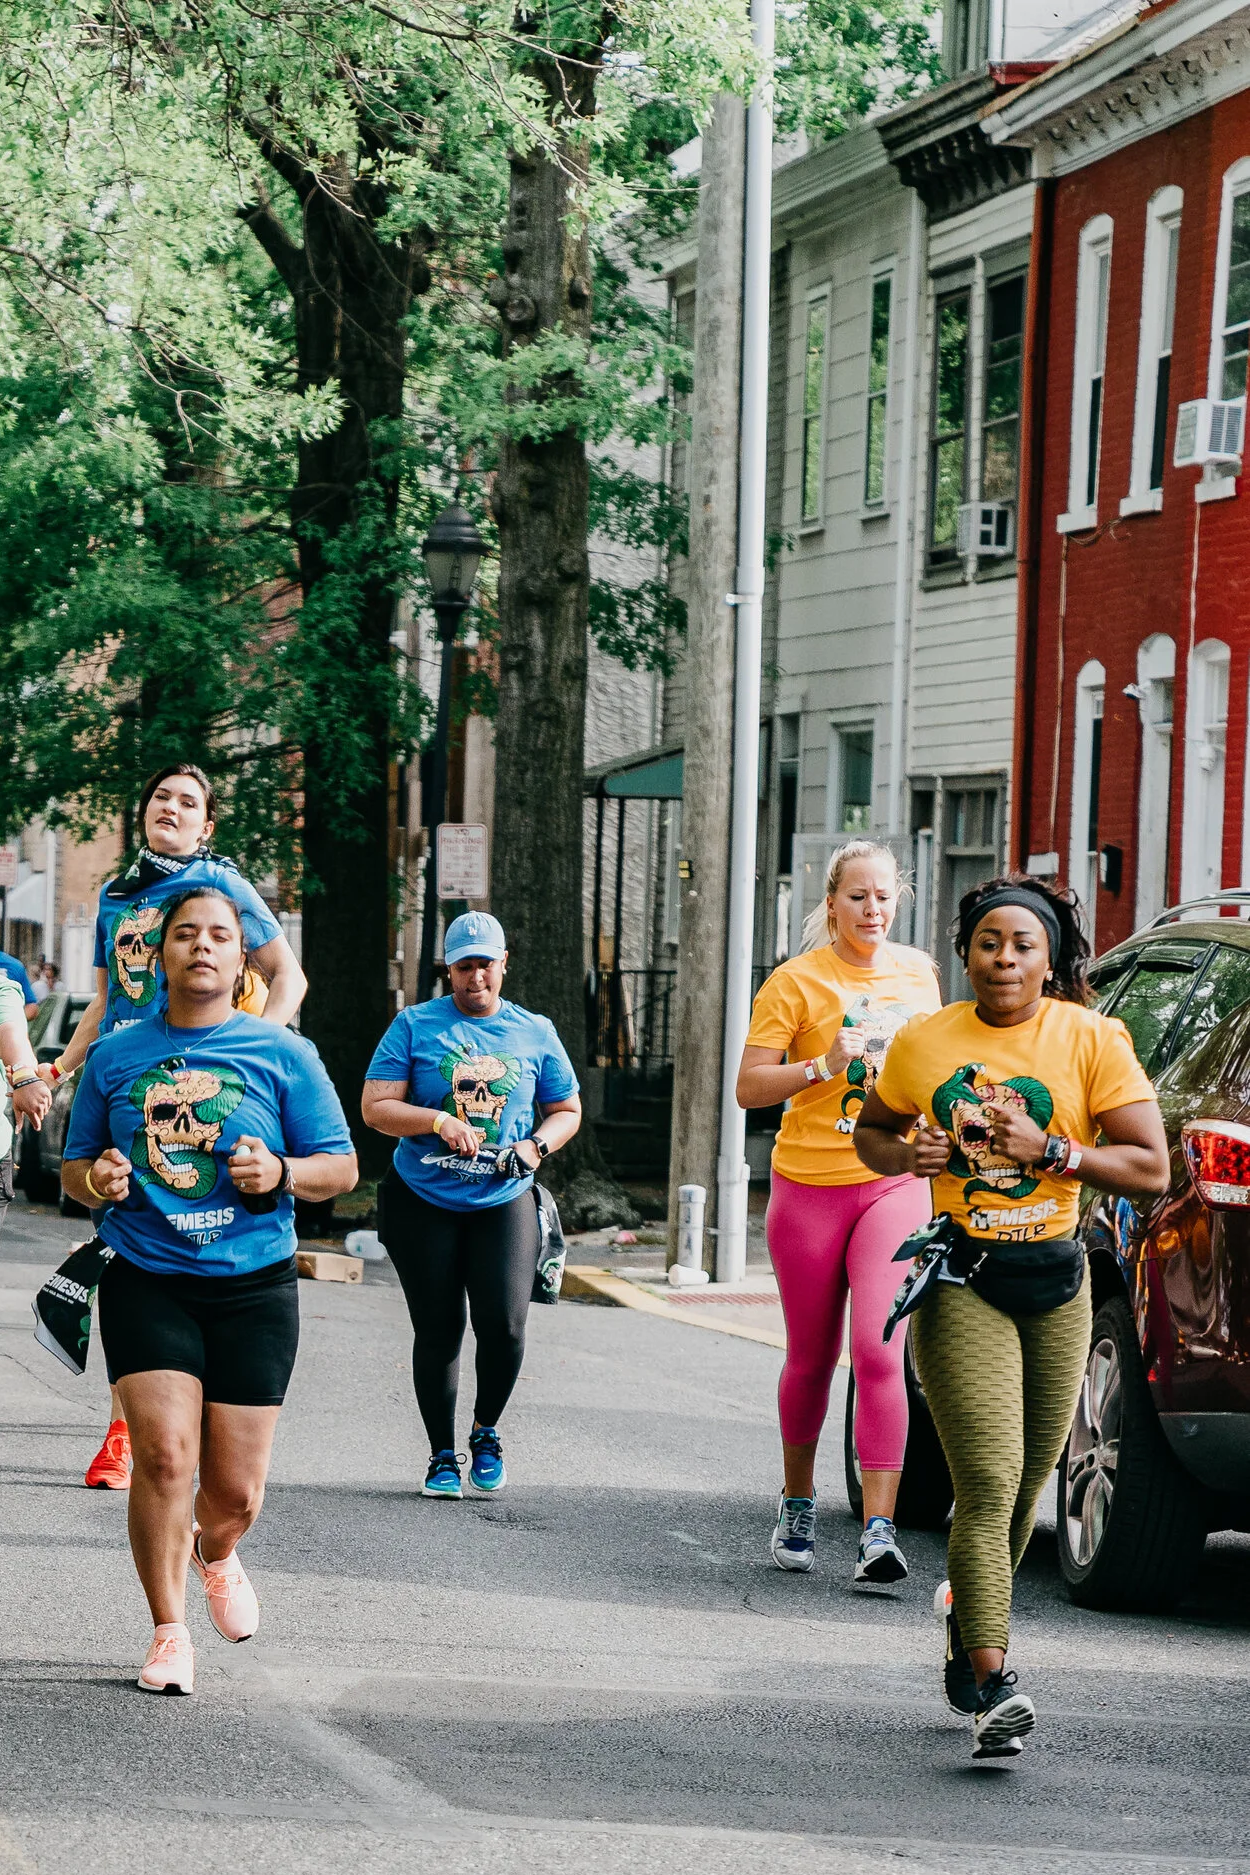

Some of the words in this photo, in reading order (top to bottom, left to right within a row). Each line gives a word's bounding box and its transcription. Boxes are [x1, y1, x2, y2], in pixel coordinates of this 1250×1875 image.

[165, 1206, 235, 1231] EMESIS
[968, 1197, 1059, 1231] NEMESIS
[187, 1229, 222, 1246] TLR
[995, 1223, 1048, 1242] DTLR
